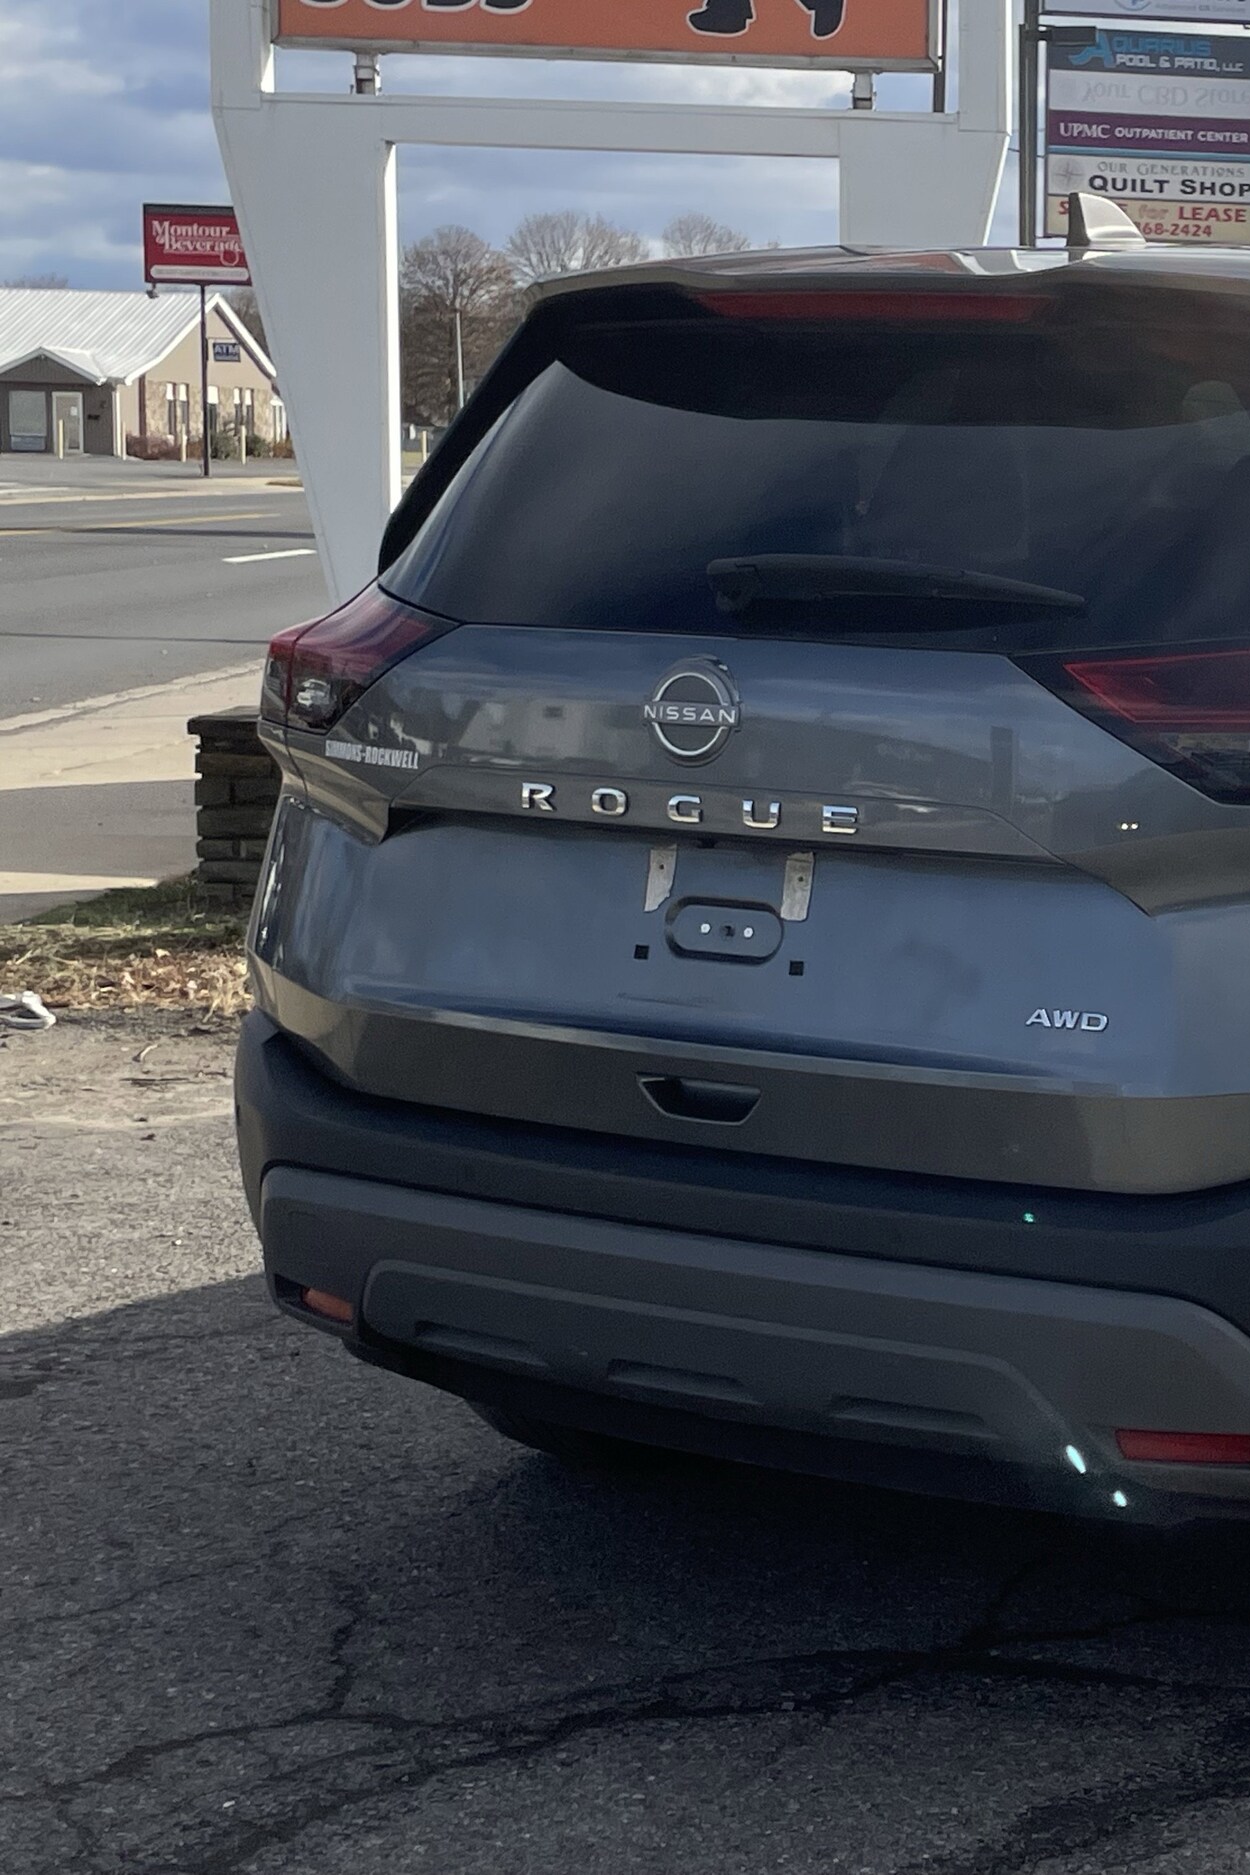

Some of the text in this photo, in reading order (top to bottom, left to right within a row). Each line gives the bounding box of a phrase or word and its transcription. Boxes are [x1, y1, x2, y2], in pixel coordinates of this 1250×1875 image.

[1116, 54, 1156, 68] POOL
[1159, 56, 1172, 68] &
[1222, 62, 1244, 72] LLC
[1059, 122, 1249, 144] UPMC OUTPATIENT CENTER
[1097, 160, 1245, 178] OUR GENERATIONS
[1088, 174, 1170, 195] QUILT
[1178, 206, 1248, 223] LEASE
[151, 219, 230, 238] Montour
[643, 704, 736, 724] NISSAN
[521, 782, 860, 835] ROGUE
[1025, 1008, 1108, 1032] AWD
